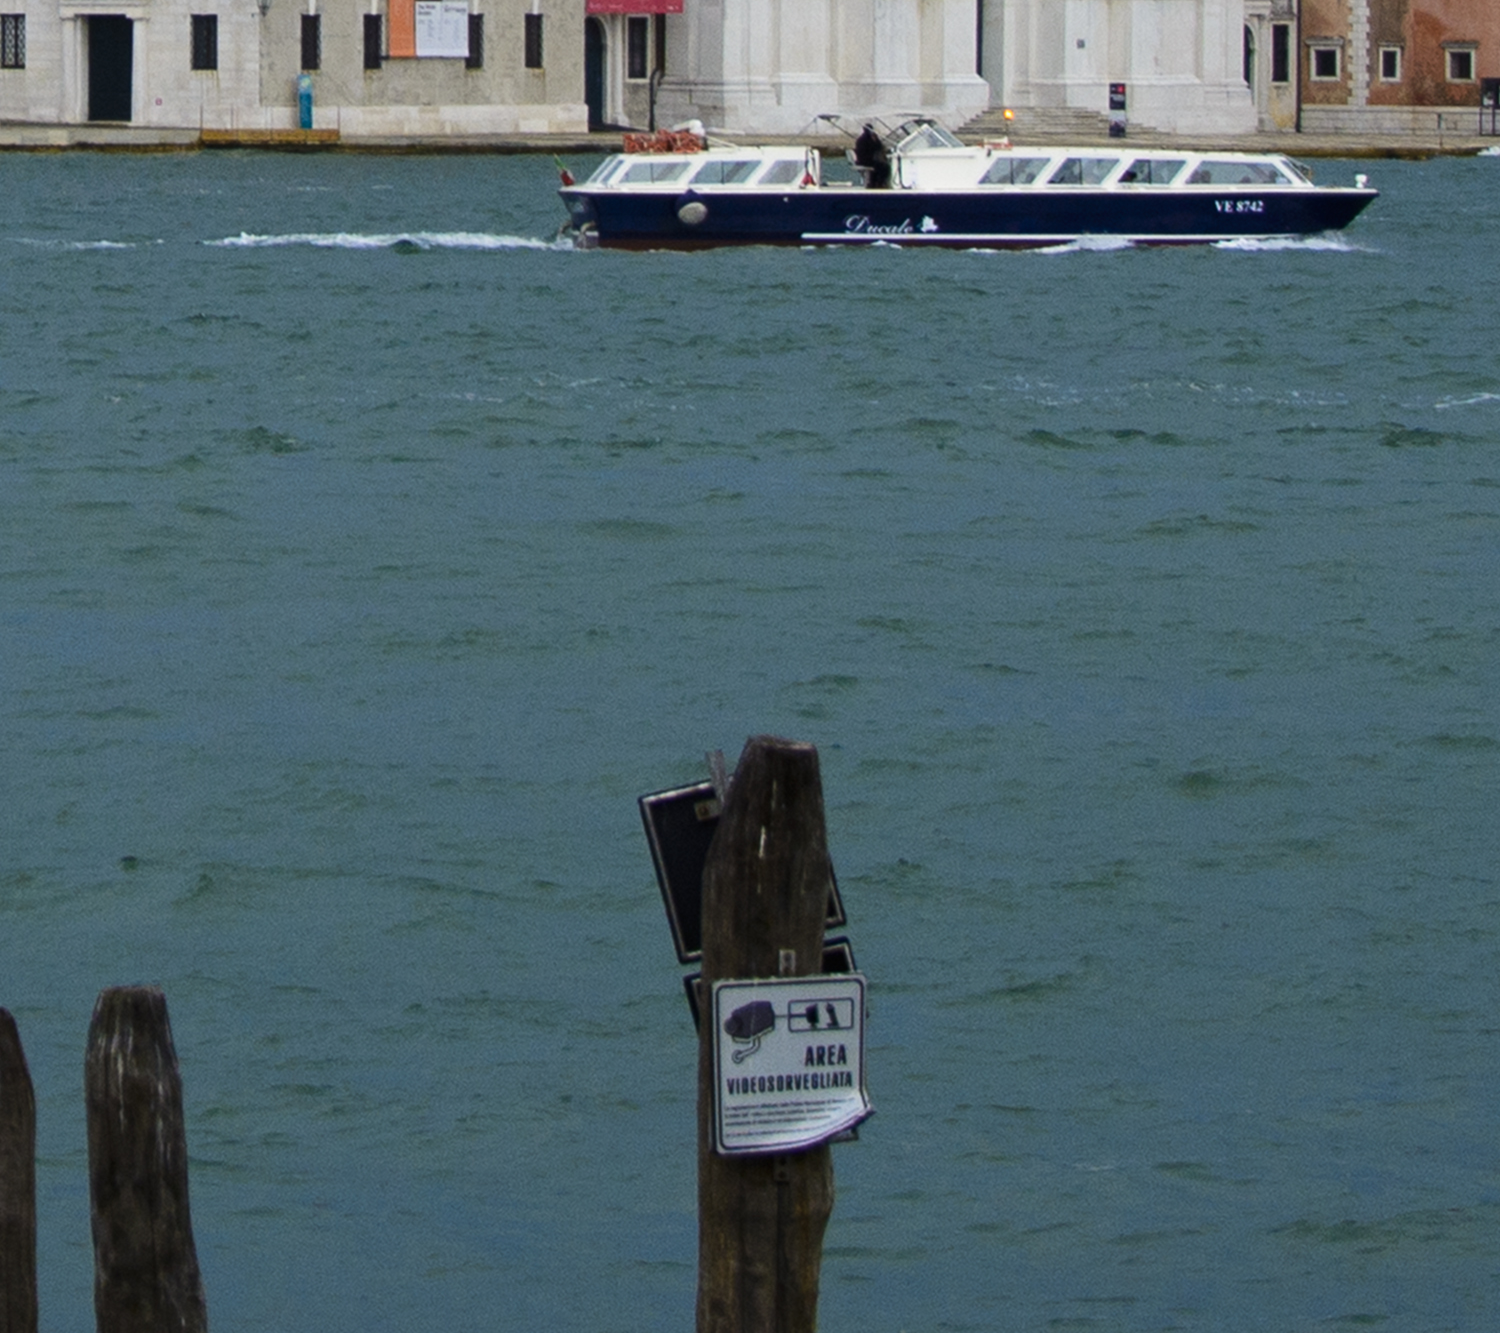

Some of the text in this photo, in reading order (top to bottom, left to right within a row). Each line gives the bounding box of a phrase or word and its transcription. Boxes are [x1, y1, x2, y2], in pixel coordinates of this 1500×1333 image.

[1215, 200, 1264, 212] VE 8742
[845, 215, 913, 234] Ducale
[804, 1044, 847, 1066] AREA
[726, 1071, 852, 1095] VIDEOSORVEGLIATA
